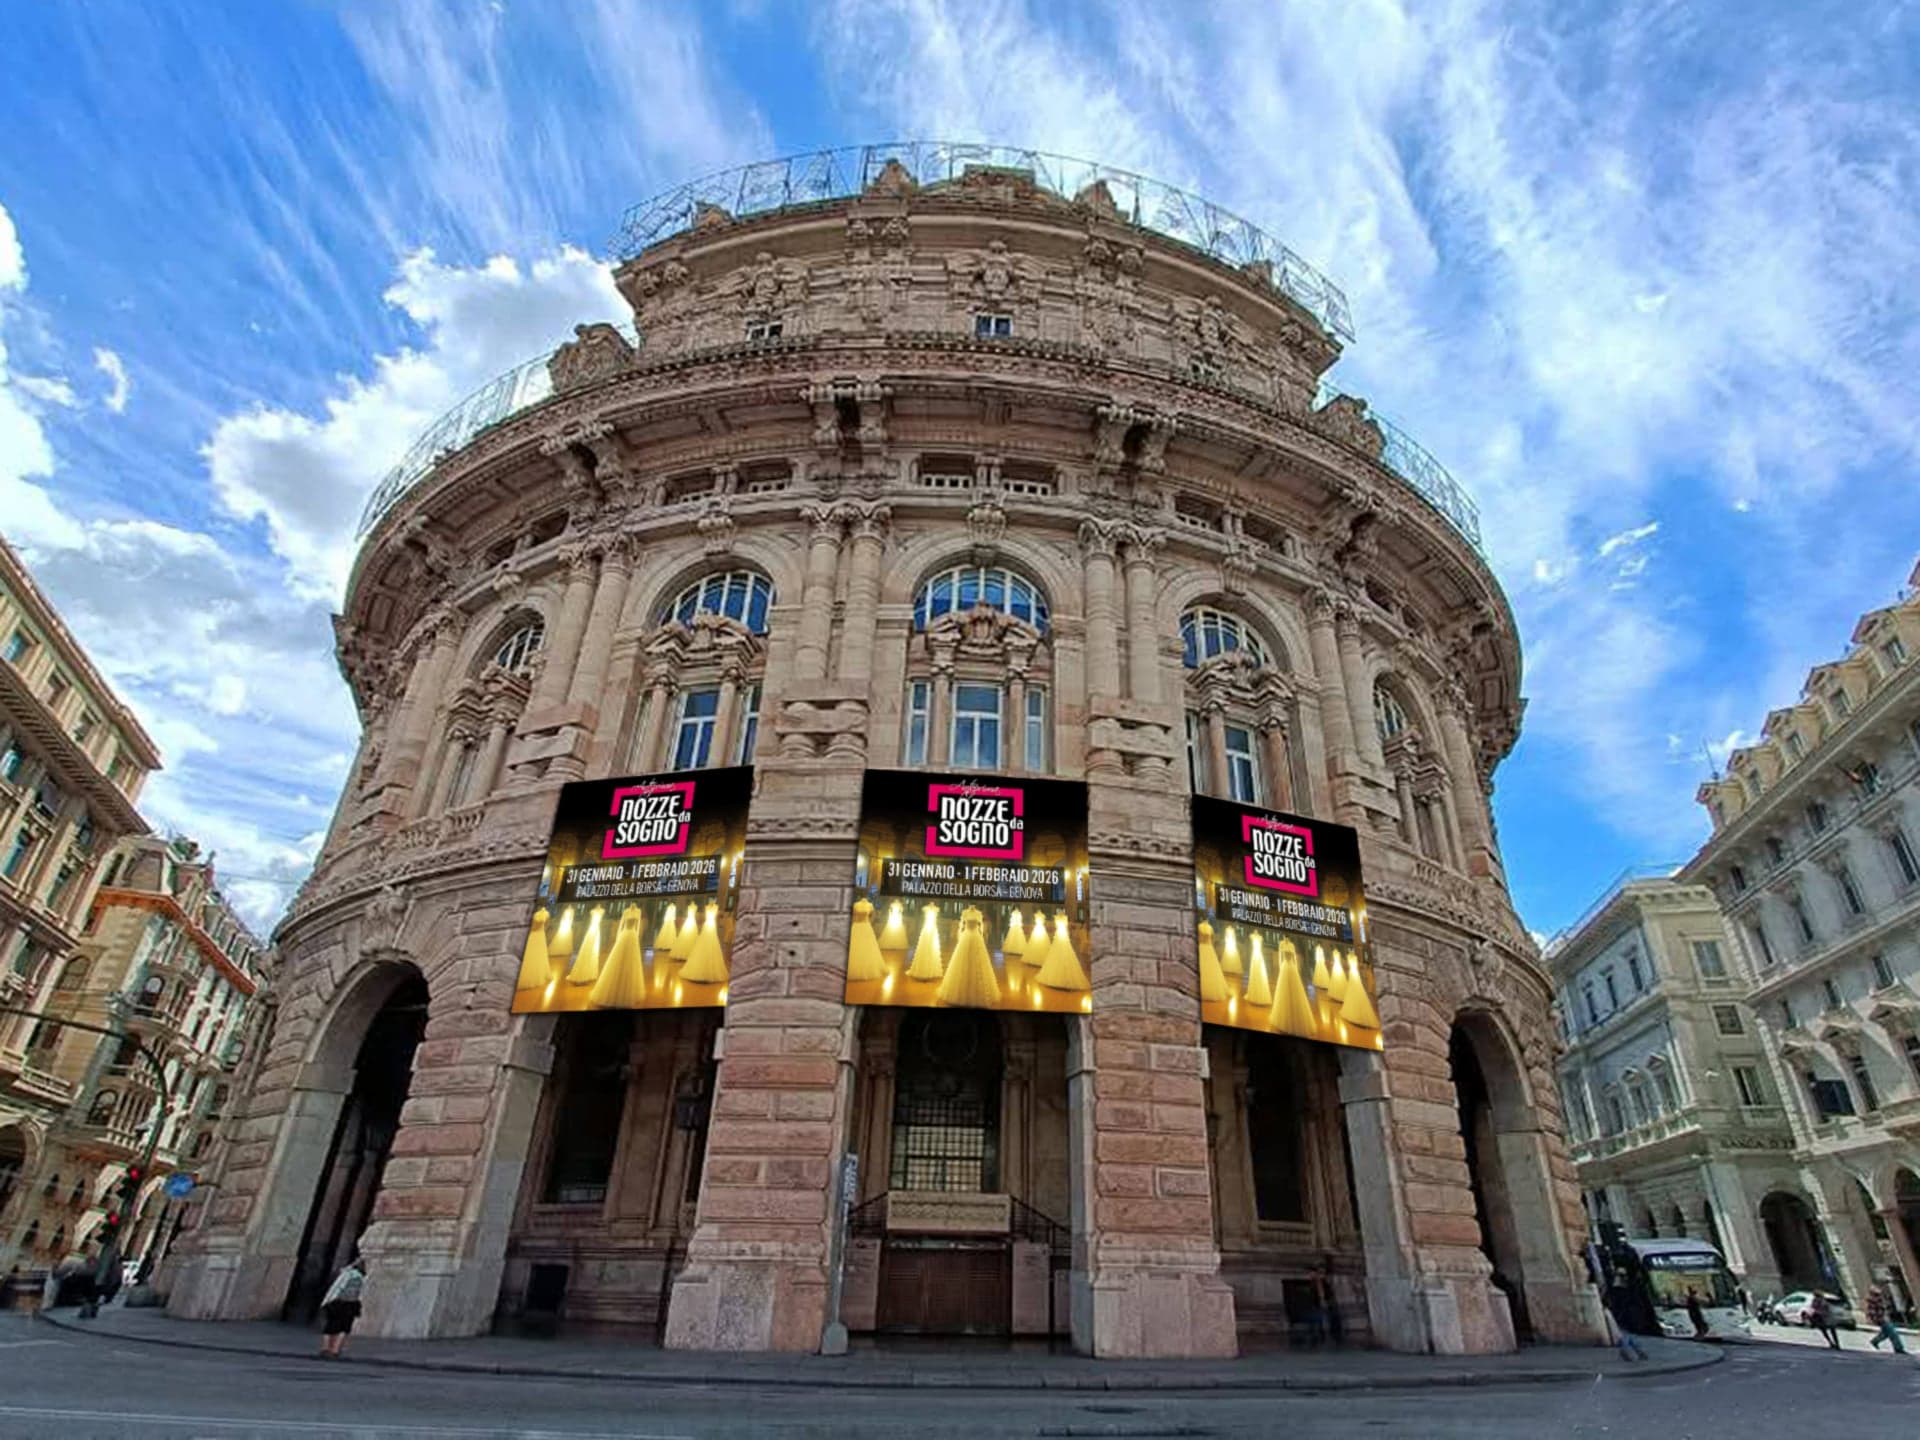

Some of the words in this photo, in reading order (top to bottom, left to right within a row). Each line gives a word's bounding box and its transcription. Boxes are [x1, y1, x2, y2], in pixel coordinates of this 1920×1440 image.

[678, 811, 691, 823] da
[1009, 817, 1024, 830] da
[567, 869, 578, 884] 31
[579, 865, 624, 882] GENNAIO
[637, 861, 689, 879] FEBBRAIO
[690, 859, 715, 875] 2026
[1305, 856, 1316, 869] da
[888, 862, 900, 877] 31
[902, 863, 955, 879] GENNAIO
[972, 866, 1029, 883] FEBBRAIO
[1031, 869, 1059, 885] 2026
[576, 884, 610, 898] PALAZZO
[610, 882, 635, 896] DELLA
[636, 879, 662, 895] BORSA
[667, 878, 699, 892] GENOVA
[901, 880, 942, 895] PALAZZO
[943, 882, 971, 897] DELLA
[973, 884, 1001, 897] BORSA
[1009, 886, 1043, 900] GENOVA
[1219, 887, 1229, 903] 31
[1231, 890, 1270, 909] GENNAIO
[1282, 899, 1325, 920] FEBBRAIO
[1326, 907, 1347, 925] 2026
